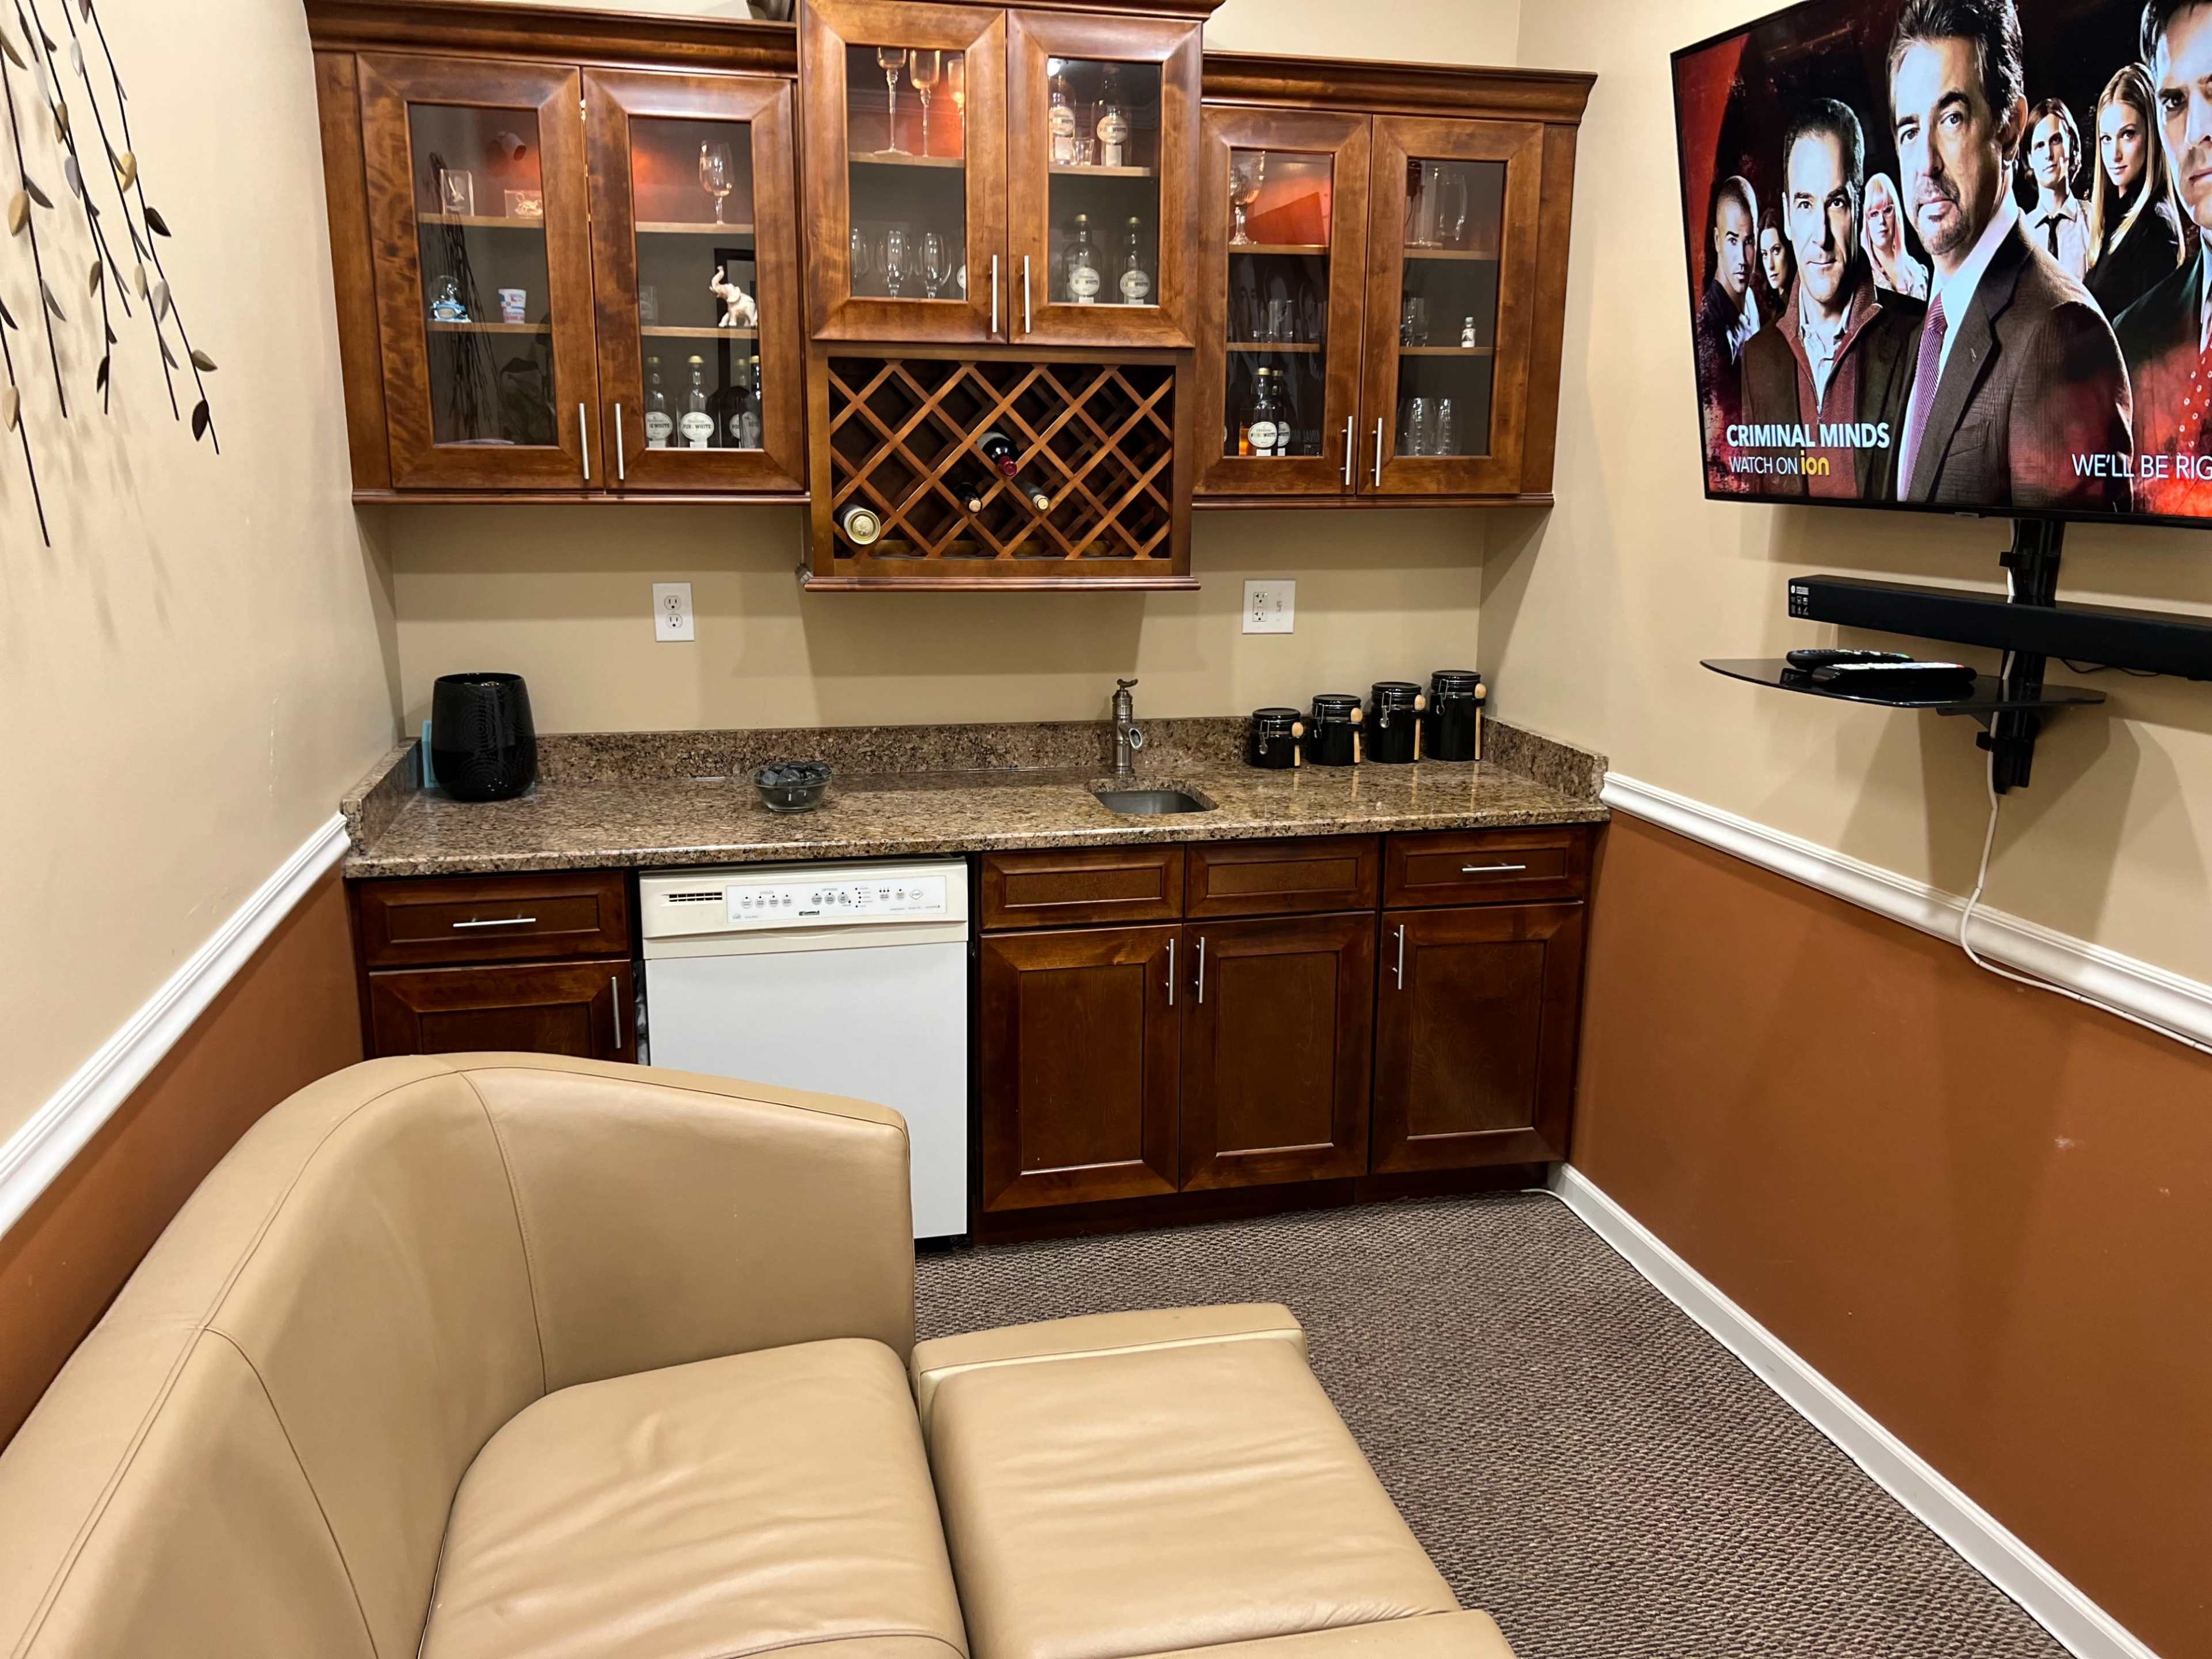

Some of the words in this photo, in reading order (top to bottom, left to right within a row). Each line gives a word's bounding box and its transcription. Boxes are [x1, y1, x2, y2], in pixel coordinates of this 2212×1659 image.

[1727, 424, 1816, 447] CRIMINAL
[1819, 422, 1890, 448] MINDS
[1729, 456, 1772, 474] WATCH
[1776, 457, 1798, 475] ON
[1801, 450, 1830, 475] ion
[2071, 453, 2134, 477] WE'LL
[2141, 454, 2169, 478] BE
